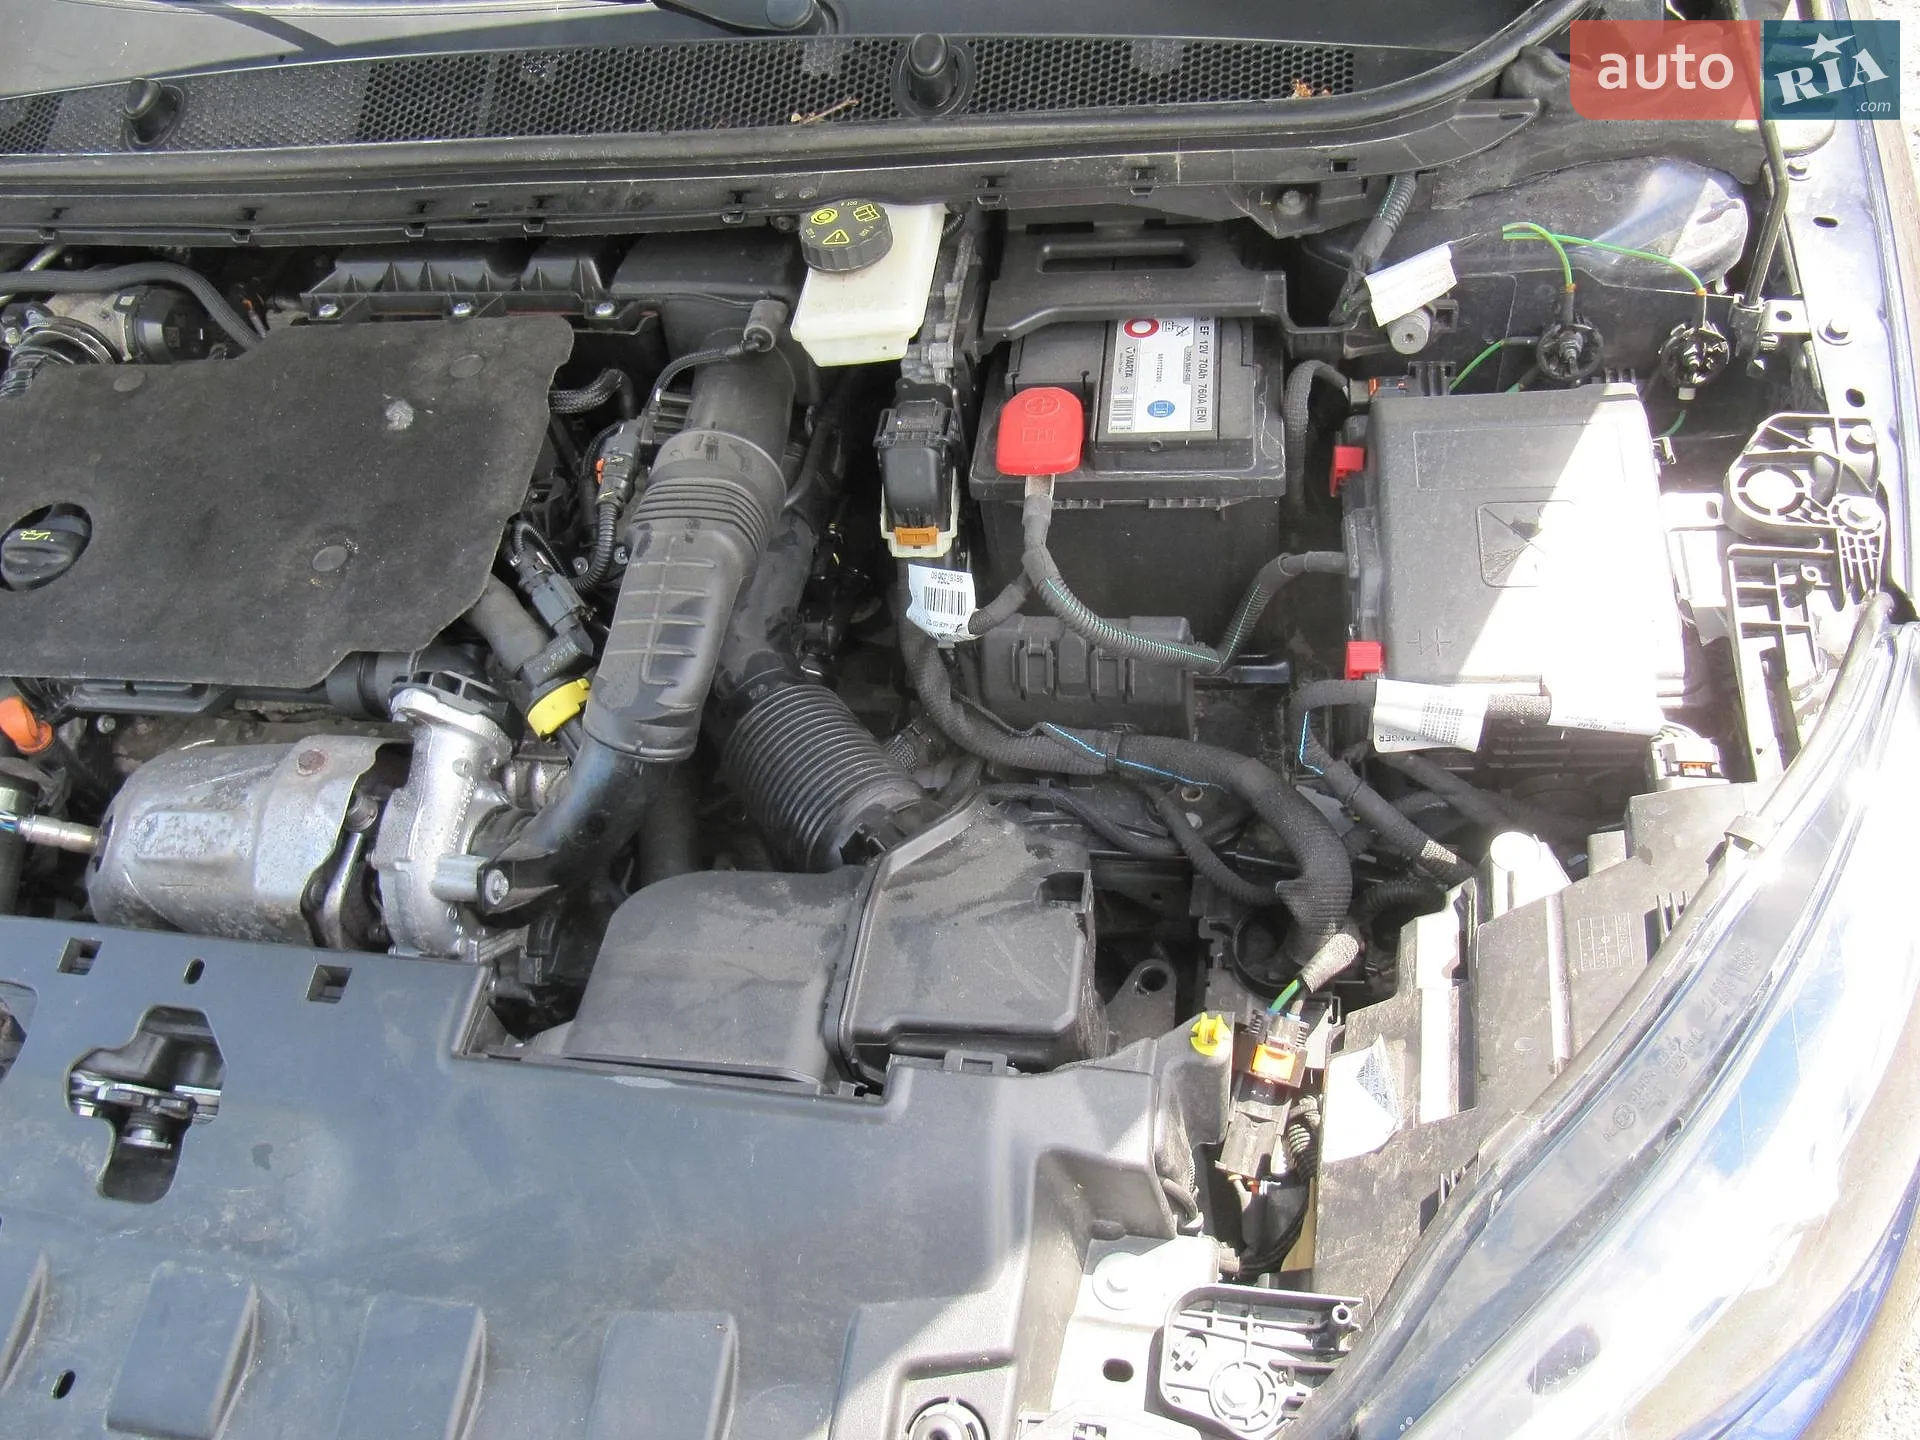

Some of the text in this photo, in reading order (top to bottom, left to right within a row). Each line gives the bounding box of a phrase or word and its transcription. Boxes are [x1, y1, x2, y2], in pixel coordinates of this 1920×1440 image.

[1200, 326, 1210, 336] EF
[1199, 341, 1209, 354] 12V
[1125, 354, 1135, 378] VARTA
[1198, 359, 1208, 379] 70Ah
[1197, 384, 1208, 404] 760A
[1195, 407, 1207, 423] (EN)
